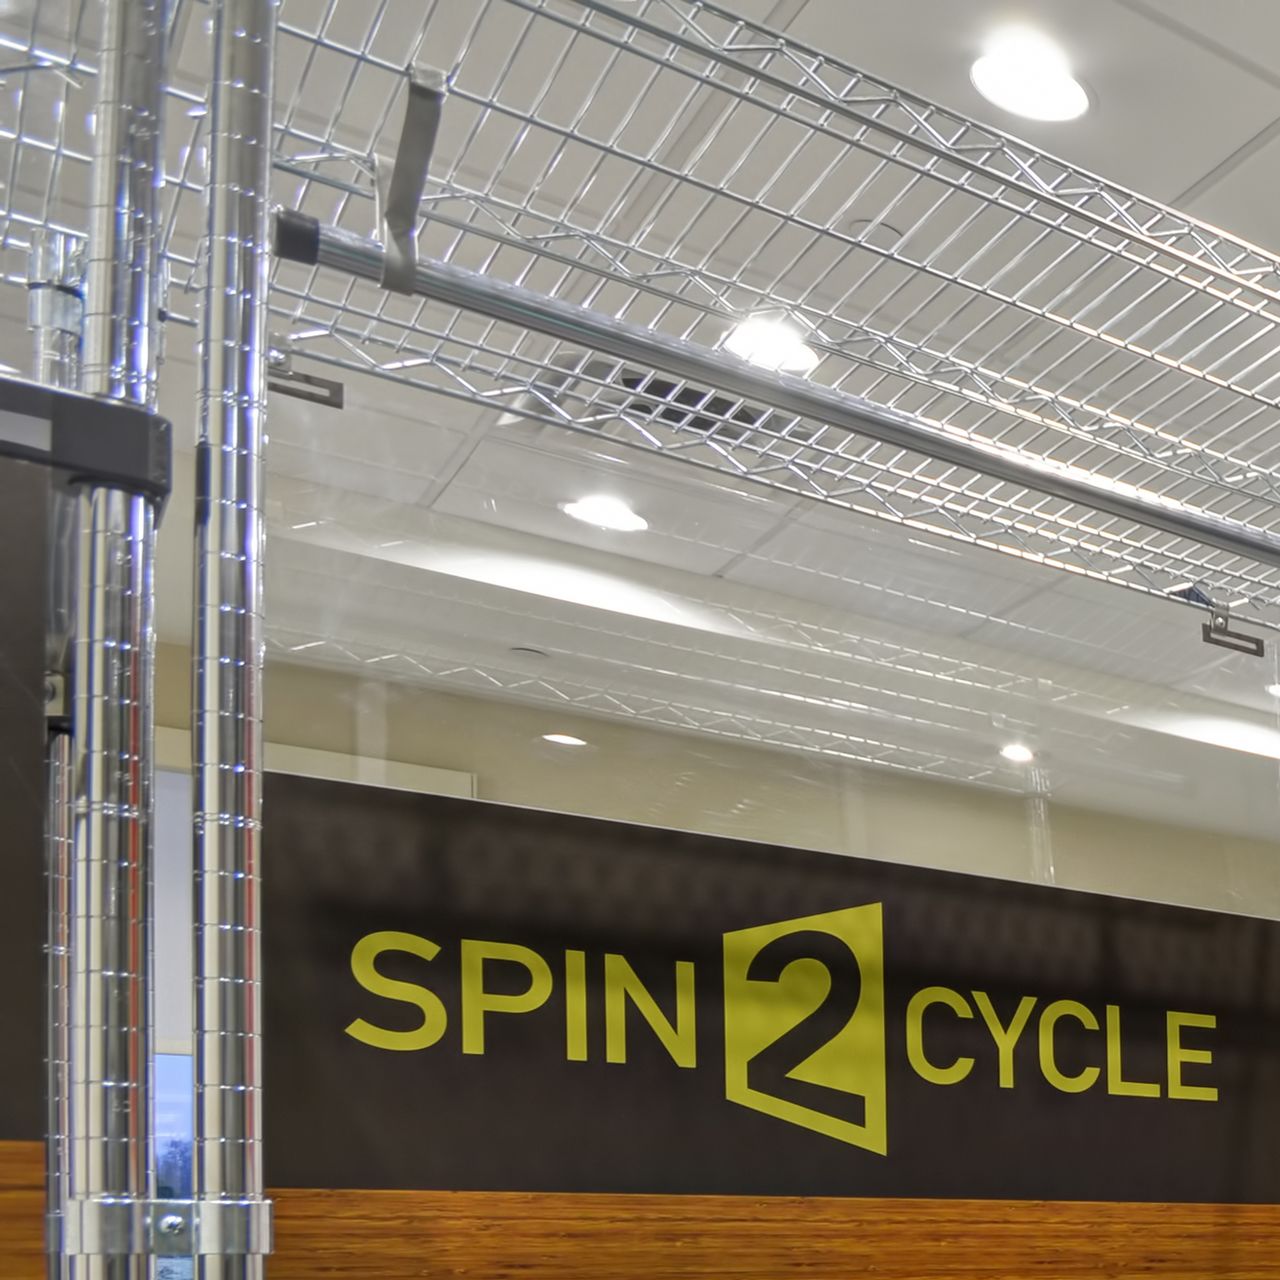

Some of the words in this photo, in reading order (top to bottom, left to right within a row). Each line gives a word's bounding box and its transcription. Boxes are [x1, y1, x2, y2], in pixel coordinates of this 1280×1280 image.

[344, 930, 697, 1069] SPIN
[746, 929, 867, 1129] 2
[904, 985, 1220, 1103] CYCLE
